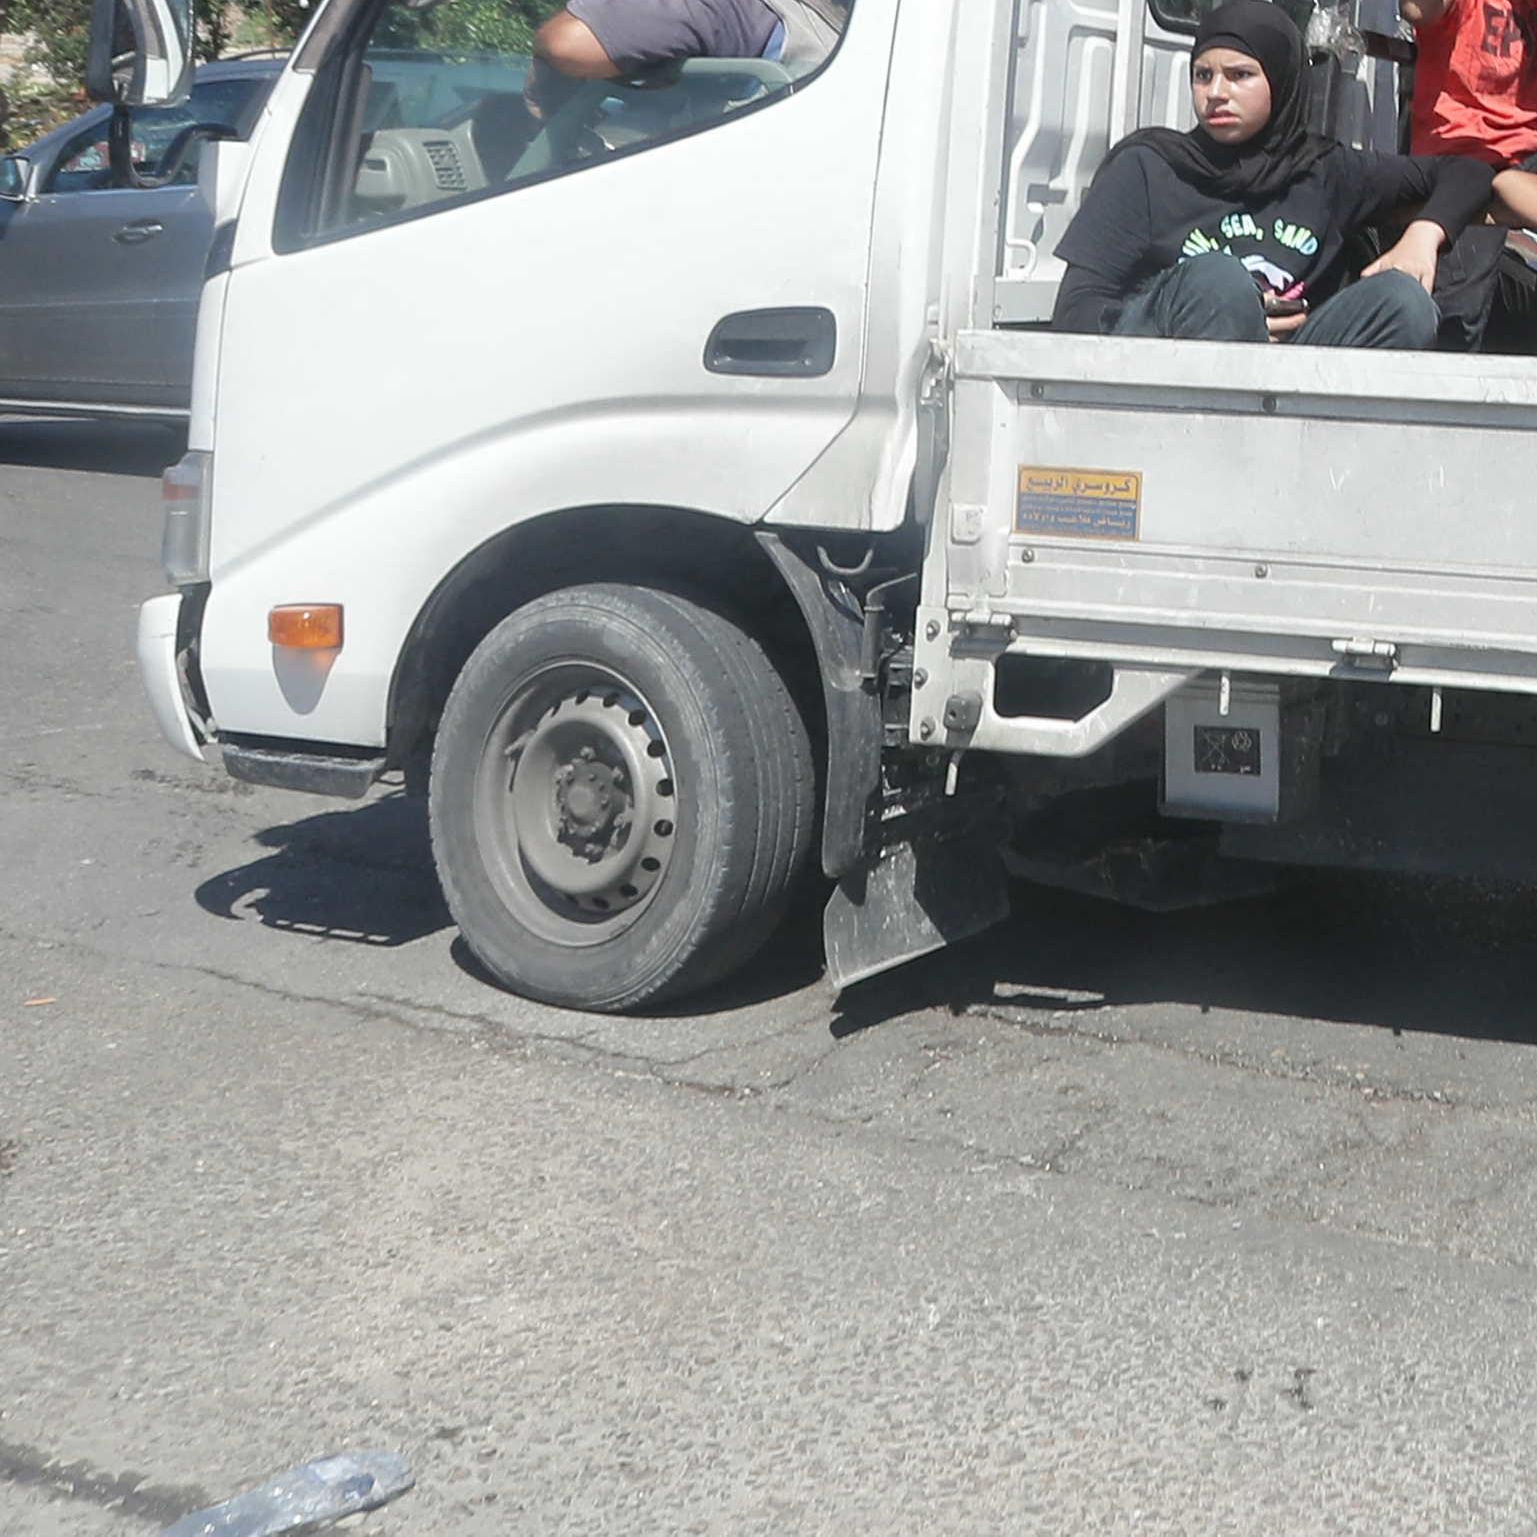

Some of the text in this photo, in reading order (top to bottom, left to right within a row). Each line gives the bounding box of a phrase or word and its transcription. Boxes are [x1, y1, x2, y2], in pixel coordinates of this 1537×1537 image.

[1178, 213, 1318, 264] UN, SEA, SAND
[1026, 474, 1068, 492] الربيع
